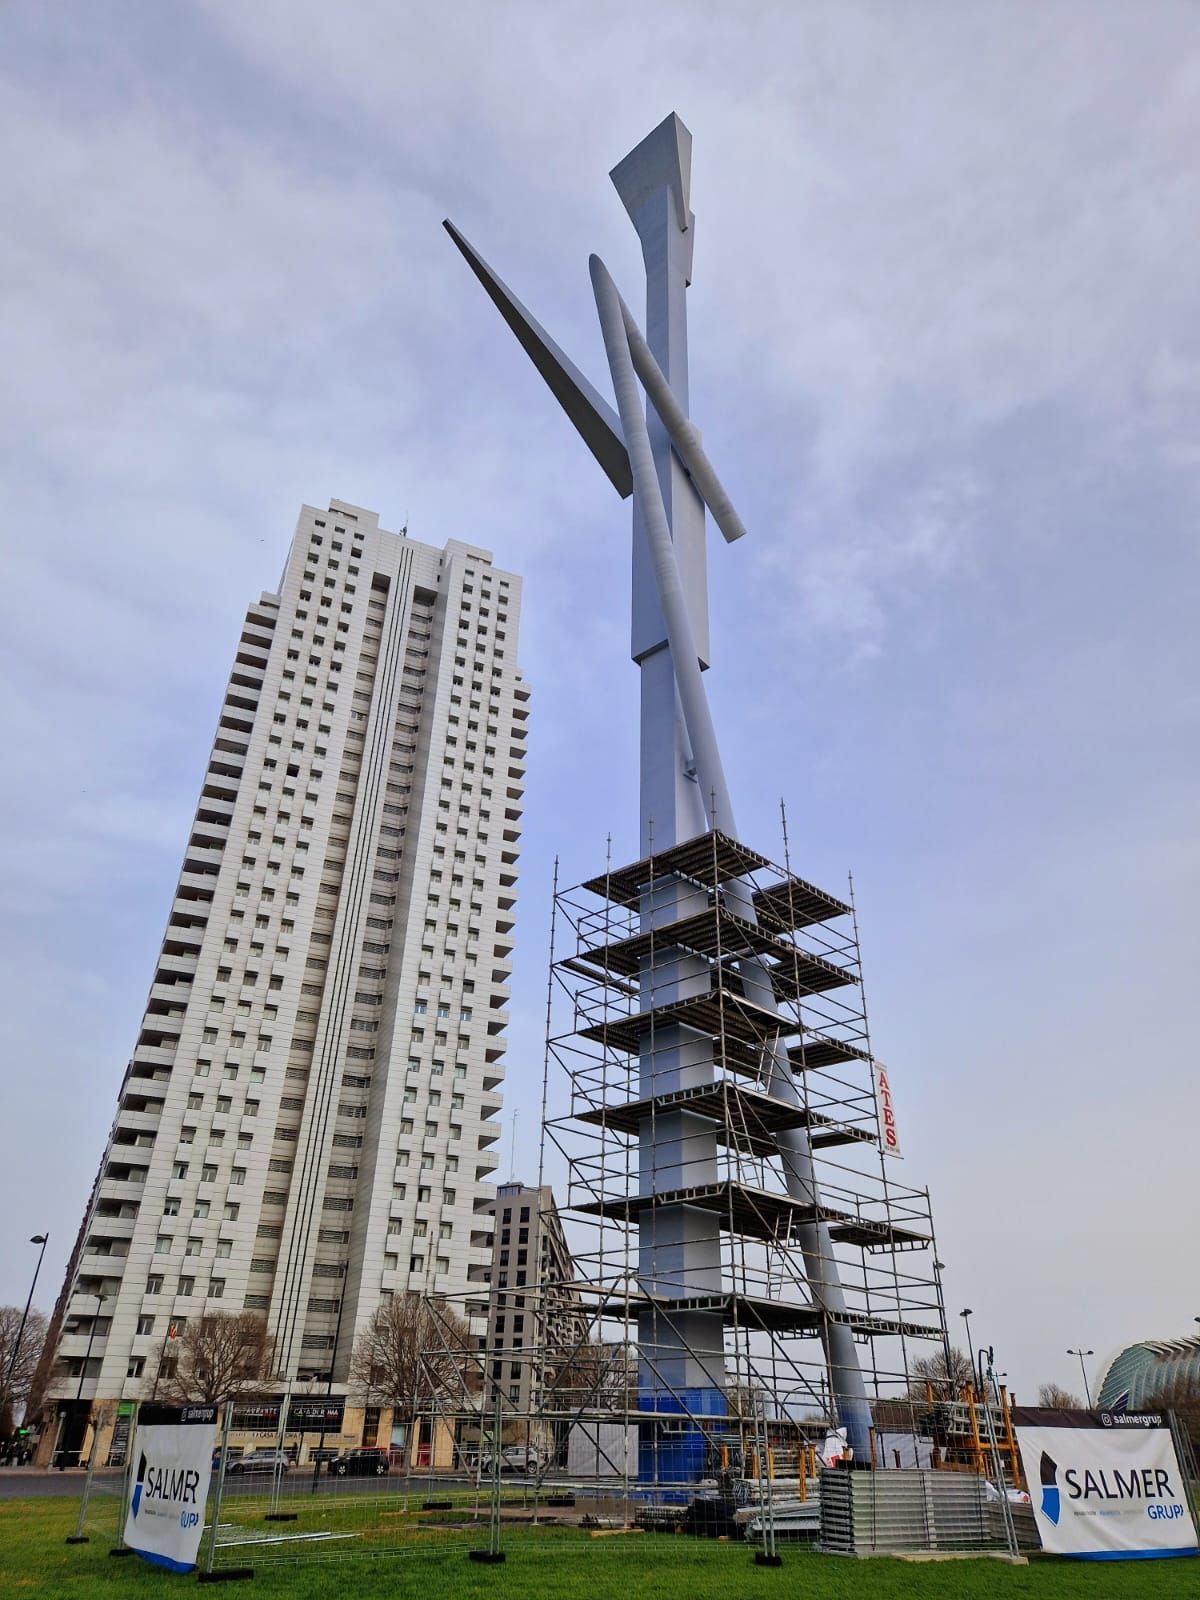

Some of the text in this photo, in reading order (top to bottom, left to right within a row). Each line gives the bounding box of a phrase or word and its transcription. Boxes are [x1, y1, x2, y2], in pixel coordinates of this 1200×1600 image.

[880, 1072, 897, 1147] ATES
[1114, 1412, 1162, 1427] salmergrup
[146, 1466, 200, 1504] SALMER
[1065, 1468, 1175, 1500] SALMER
